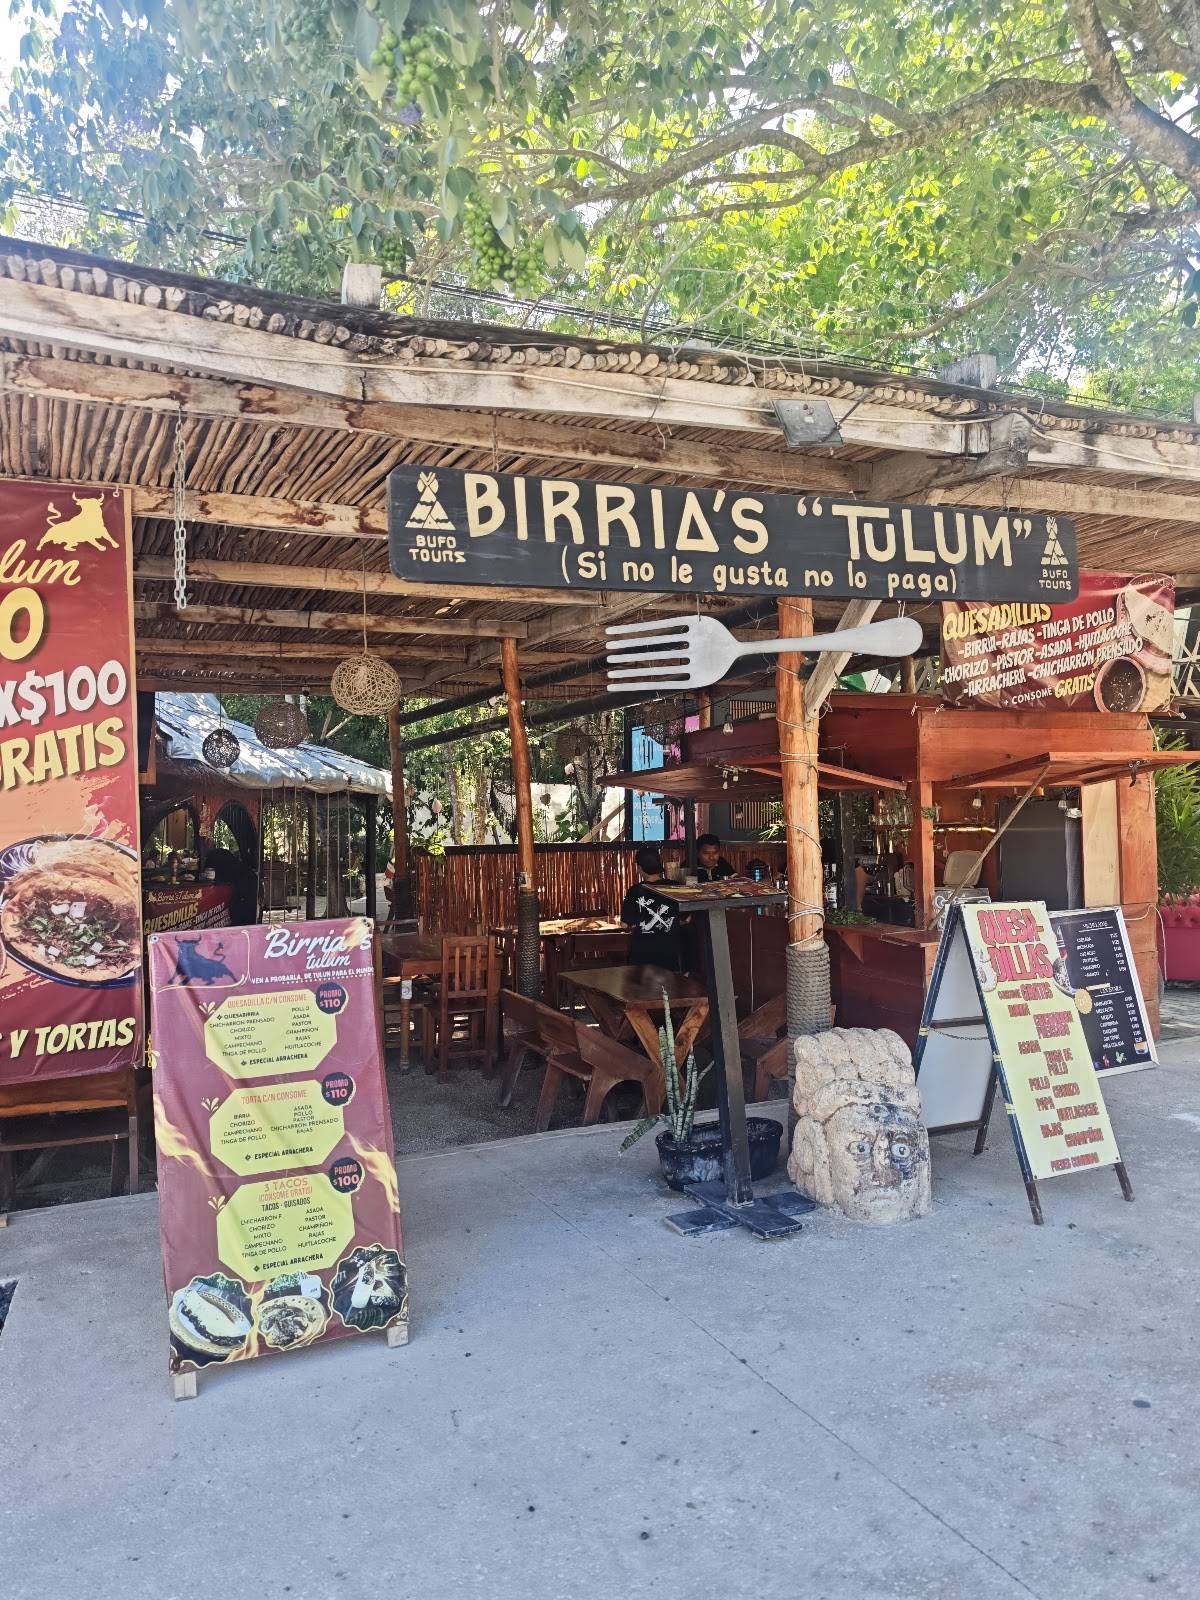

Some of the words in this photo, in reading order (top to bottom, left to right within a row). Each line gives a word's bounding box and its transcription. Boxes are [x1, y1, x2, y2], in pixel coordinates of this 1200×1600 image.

[464, 472, 769, 555] BIRRIA'S
[415, 534, 457, 549] BUFO
[408, 548, 467, 563] TOURS
[622, 561, 654, 583] no
[671, 555, 693, 584] le
[713, 560, 789, 592] gusta
[804, 568, 834, 588] no
[847, 560, 867, 589] lo
[888, 568, 957, 598] paga)
[1042, 569, 1068, 579] BUFO
[1038, 579, 1072, 591] TOURS
[943, 602, 1052, 640] QUESADILLAS
[1072, 614, 1085, 632] DE
[1086, 607, 1115, 629] POLLO
[1054, 671, 1096, 698] GRATIS
[0, 716, 125, 790] RATIS
[143, 902, 199, 935] QUESADILLAS
[306, 951, 351, 970] tulum
[987, 943, 1054, 982] DILLAS
[252, 977, 266, 985] VEN
[320, 989, 342, 998] PROMO
[227, 996, 265, 1008] QUESADILLA
[320, 999, 341, 1008] $110
[10, 1029, 29, 1059] Y
[35, 1017, 136, 1056] TORTAS
[224, 1041, 263, 1049] CAMPECHANO
[248, 1047, 267, 1055] POLLO
[249, 1057, 275, 1065] ESPECIAL
[276, 1053, 309, 1062] ARRACHERA
[325, 1079, 348, 1088] PROMO
[1028, 1076, 1050, 1091] POLLO
[241, 1095, 262, 1105] TORTA
[325, 1089, 348, 1099] $110
[230, 1120, 256, 1128] CHORIZO
[271, 1122, 307, 1132] CHICHARRON
[308, 1117, 339, 1127] PRENSADO
[224, 1127, 263, 1137] CAMPECHANO
[247, 1134, 267, 1142] POLLO
[254, 1151, 281, 1160] ESPECIAL
[281, 1146, 314, 1156] ARRACHERA
[334, 1164, 358, 1174] PROMO
[264, 1183, 270, 1192] 3
[273, 1177, 309, 1190] TACOS
[333, 1175, 360, 1187] $100
[262, 1203, 280, 1212] TACOS
[284, 1197, 311, 1208] GUISADOS
[306, 1206, 324, 1214] ASADA
[305, 1214, 326, 1222] PASTOR
[249, 1223, 276, 1233] CHORIZO
[253, 1232, 272, 1240] MIXTO
[244, 1238, 283, 1250] CAMPECHANO
[242, 1251, 258, 1259] TINGA
[267, 1245, 287, 1255] POLLO
[262, 1259, 289, 1270] ESPECIAL
[289, 1253, 324, 1265] ARRACHERA
